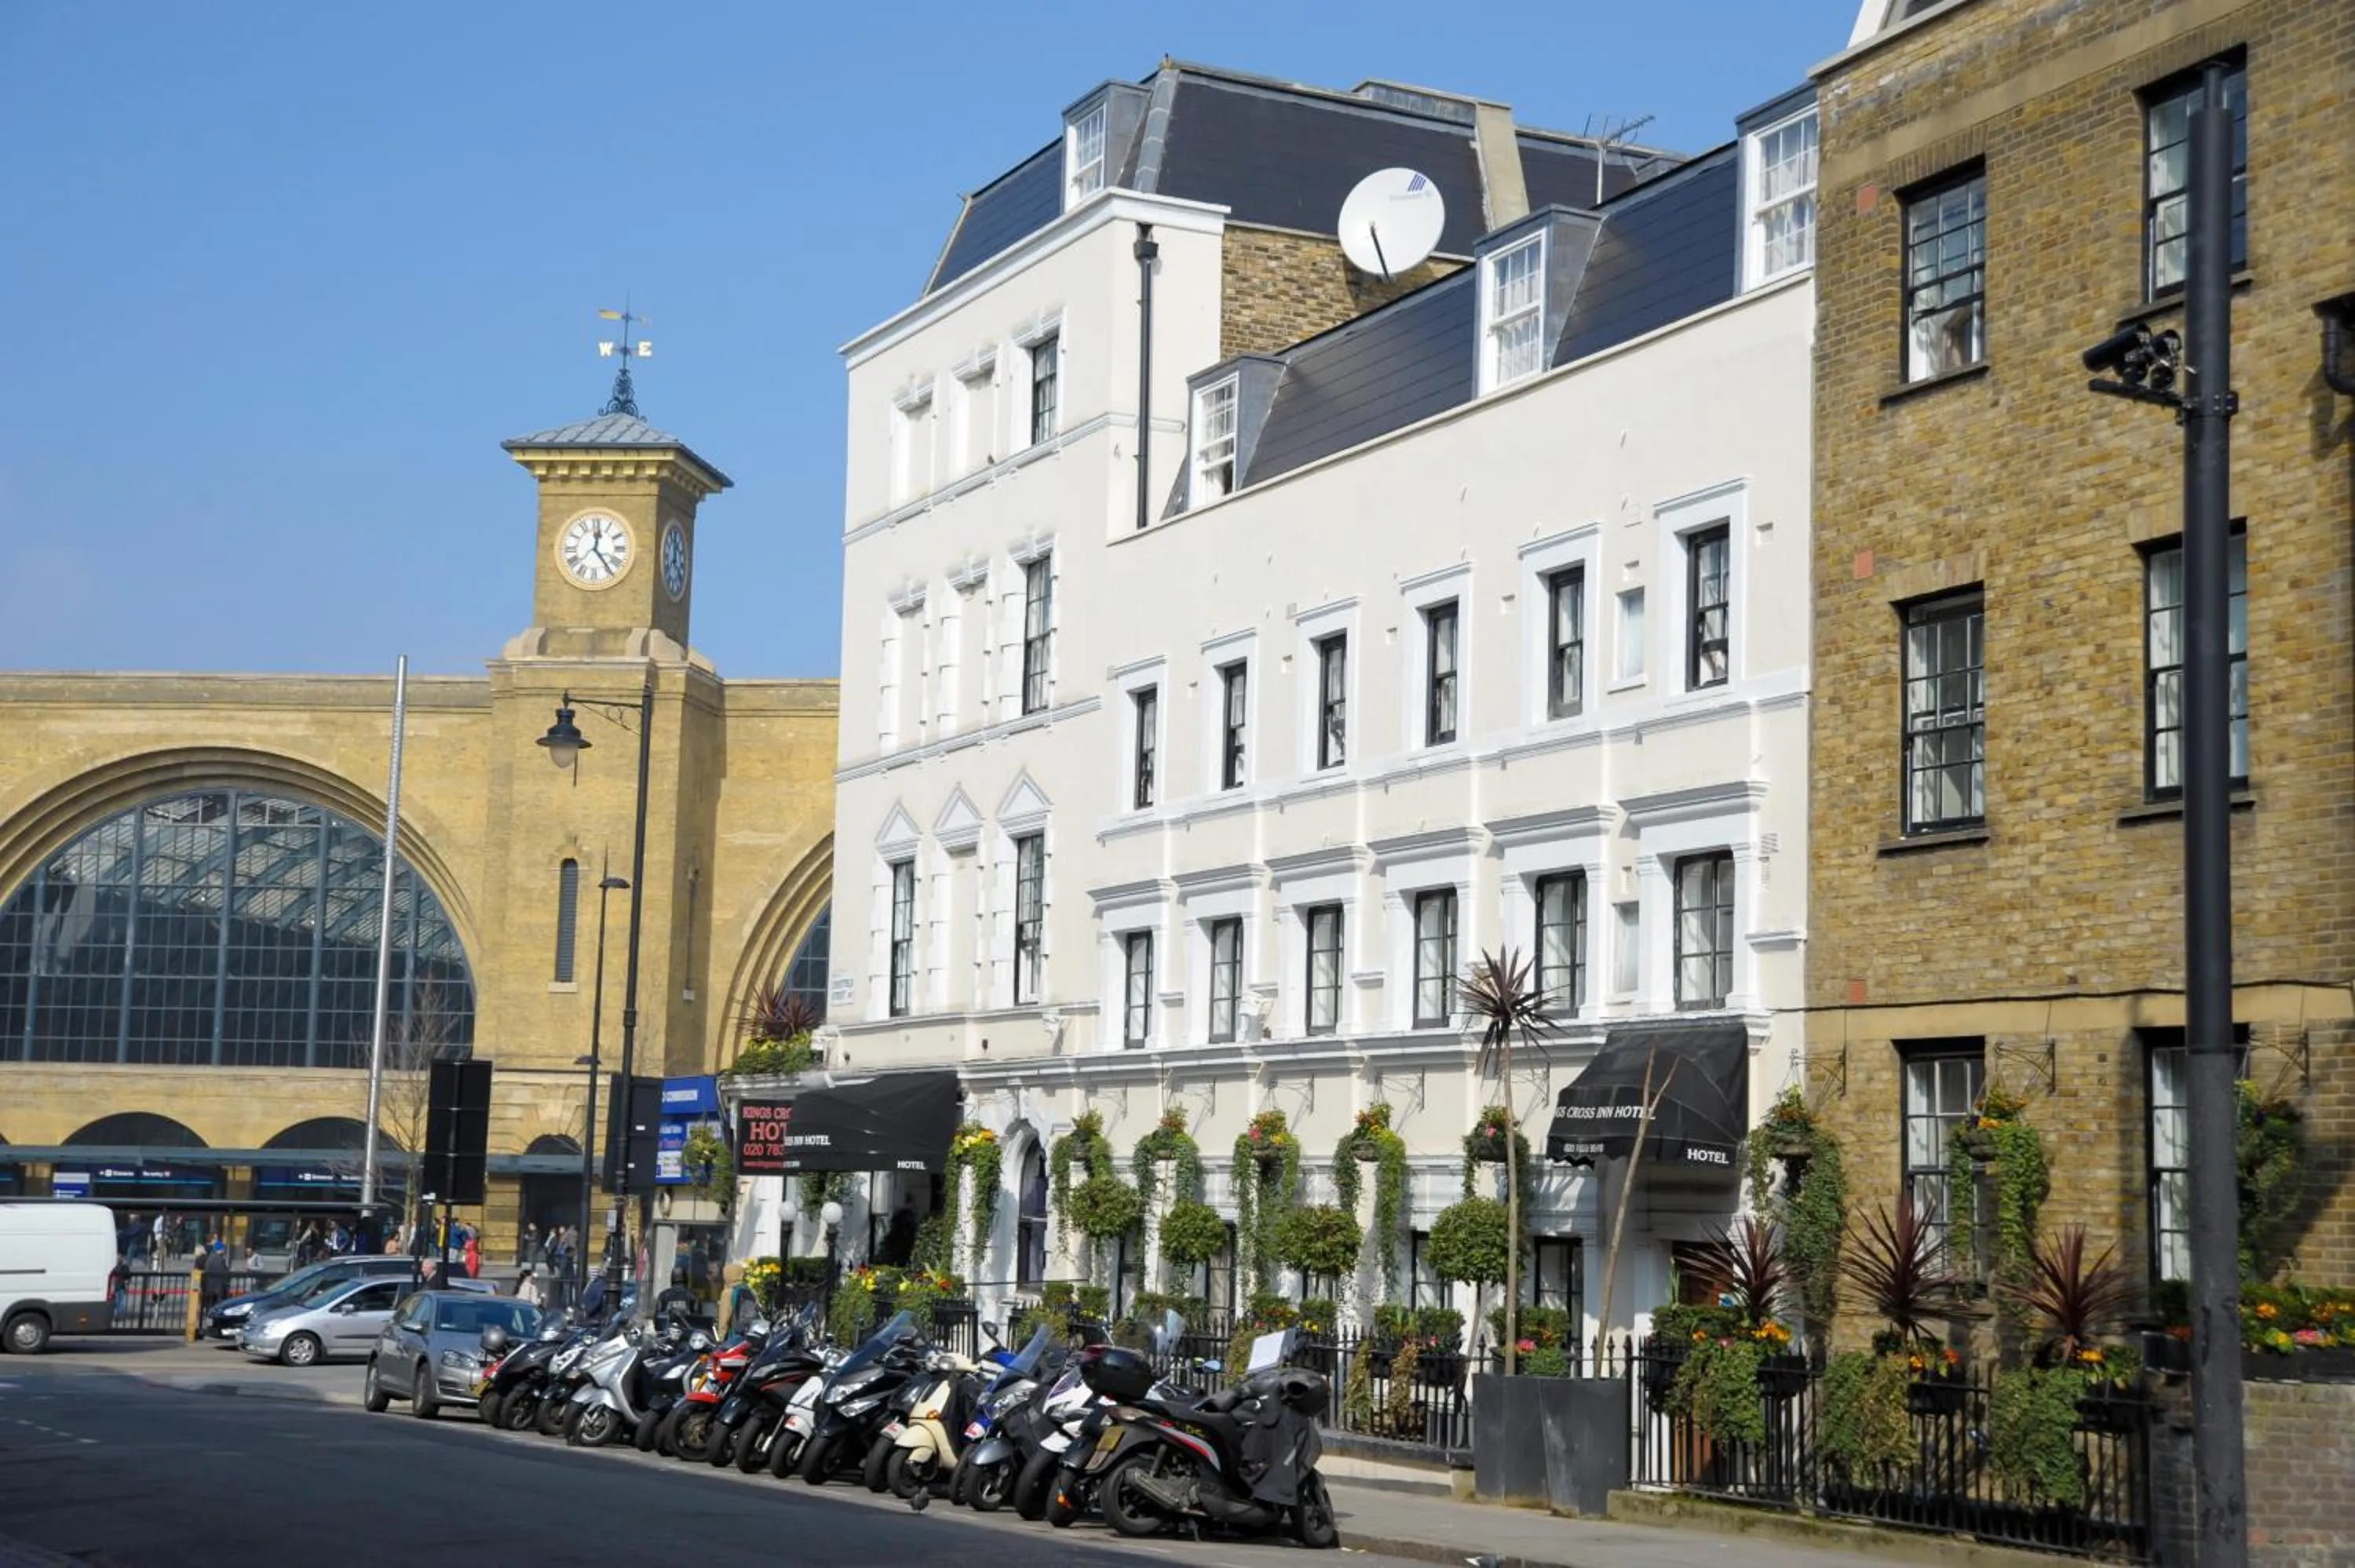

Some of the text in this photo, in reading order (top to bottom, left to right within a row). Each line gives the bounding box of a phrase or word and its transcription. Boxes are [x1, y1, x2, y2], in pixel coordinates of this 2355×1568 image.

[598, 341, 652, 357] W E
[743, 1106, 771, 1118] KINGS
[1566, 1105, 1595, 1118] CROSS
[1596, 1105, 1614, 1118] INN
[750, 1121, 788, 1140] HOT
[805, 1134, 831, 1146] HOTEL
[743, 1143, 764, 1156] 020
[1687, 1148, 1729, 1164] HOTEL
[897, 1160, 926, 1170] HOTEL
